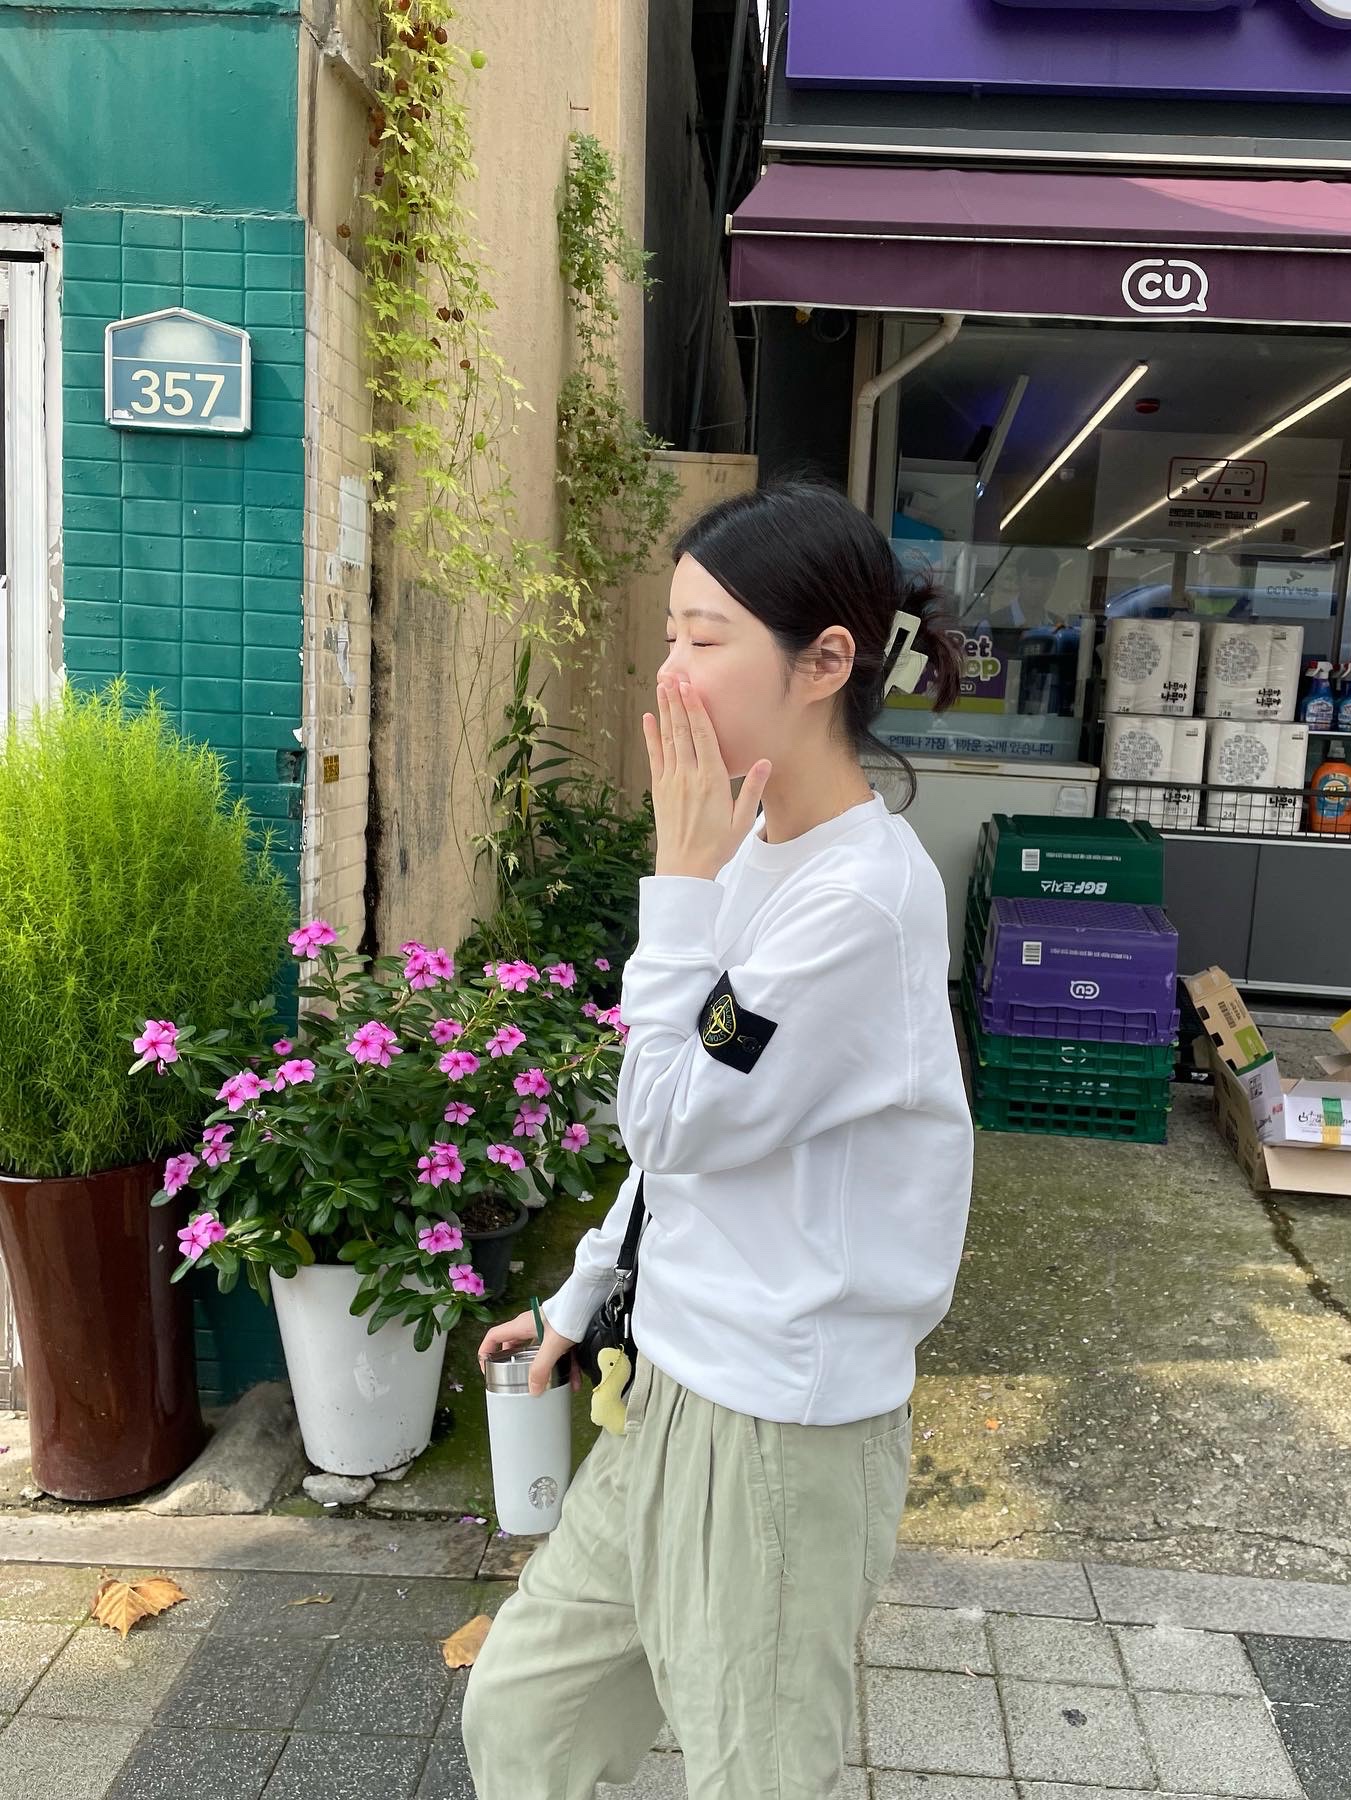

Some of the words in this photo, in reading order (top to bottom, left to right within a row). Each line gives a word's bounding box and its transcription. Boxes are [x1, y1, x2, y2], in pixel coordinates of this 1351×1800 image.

[1138, 272, 1191, 300] CU
[130, 369, 226, 418] 357
[1163, 681, 1188, 692] 나무야
[1258, 687, 1282, 697] 나무야
[1161, 691, 1187, 703] 나무야
[1256, 697, 1282, 708] 나무야
[924, 737, 946, 750] 가장
[1009, 742, 1054, 756] 있습니다
[1041, 880, 1107, 895] BGF로지스
